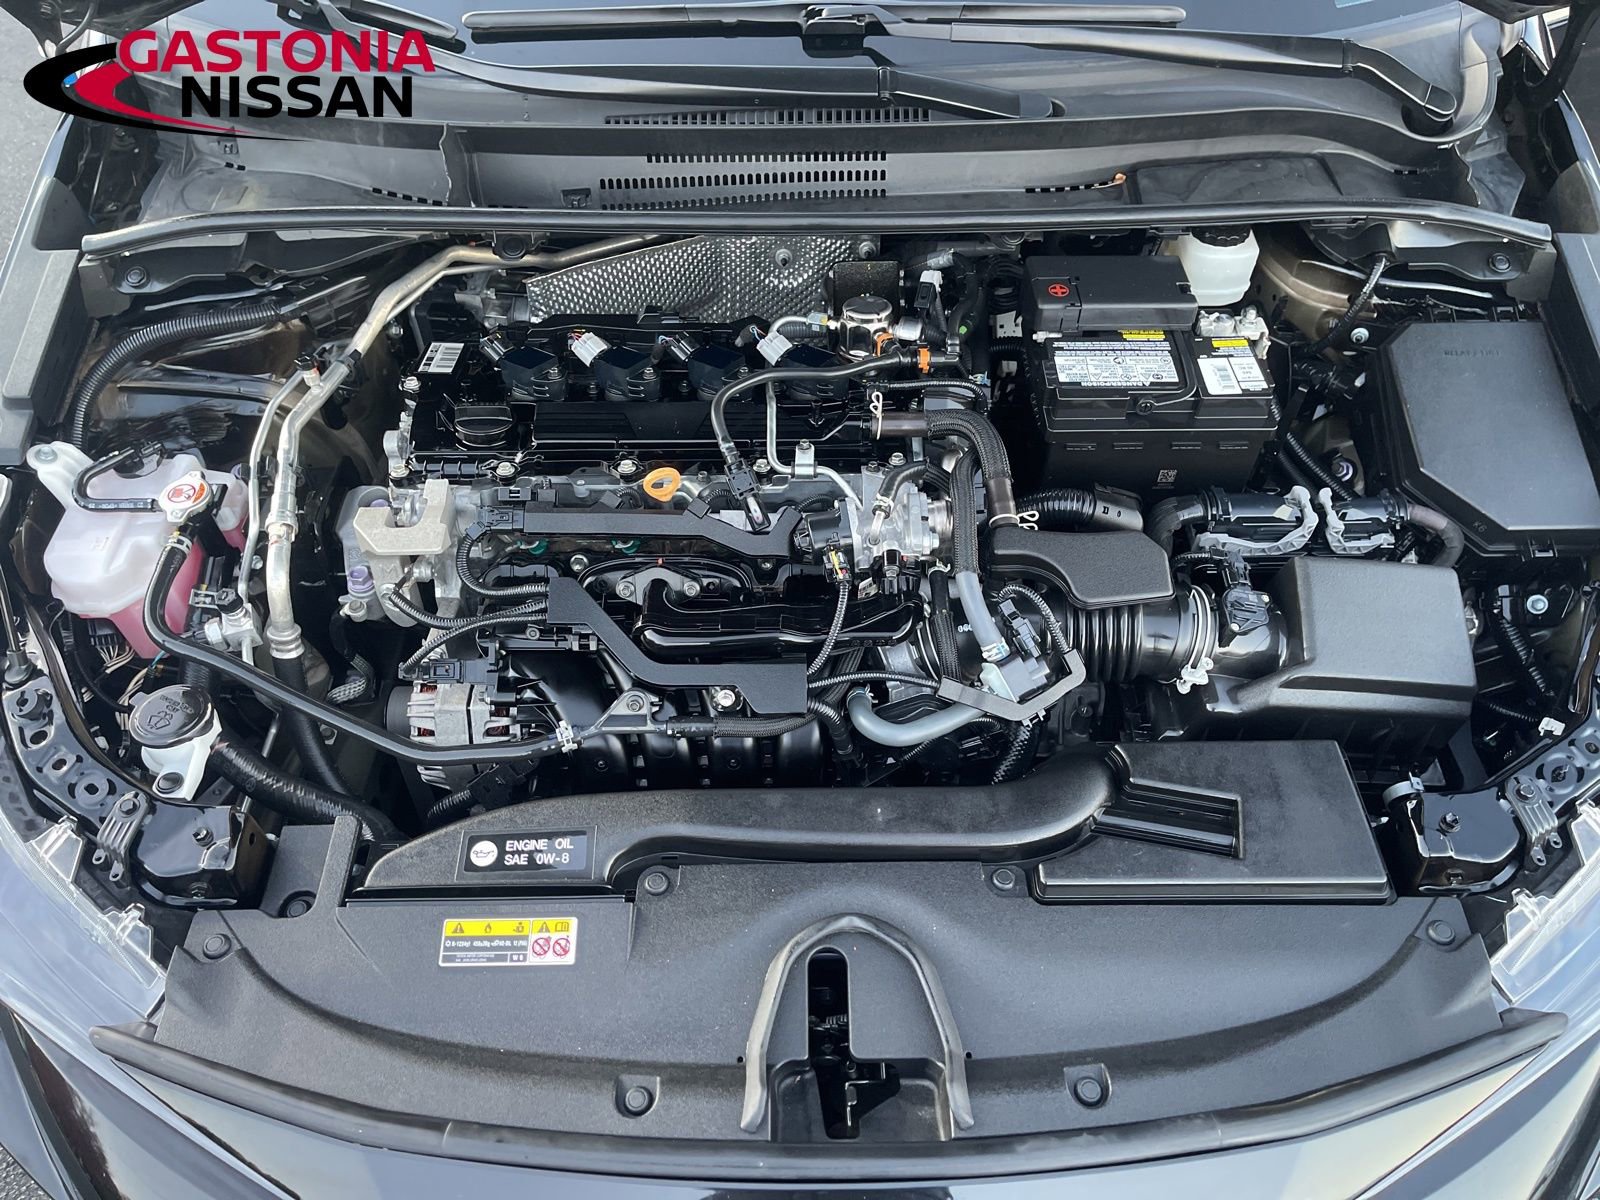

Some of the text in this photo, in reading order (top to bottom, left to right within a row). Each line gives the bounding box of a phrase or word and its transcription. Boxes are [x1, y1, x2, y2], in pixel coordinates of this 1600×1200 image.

[505, 837, 574, 851] ENGINE OIL
[503, 852, 570, 866] SAE 0W-8
